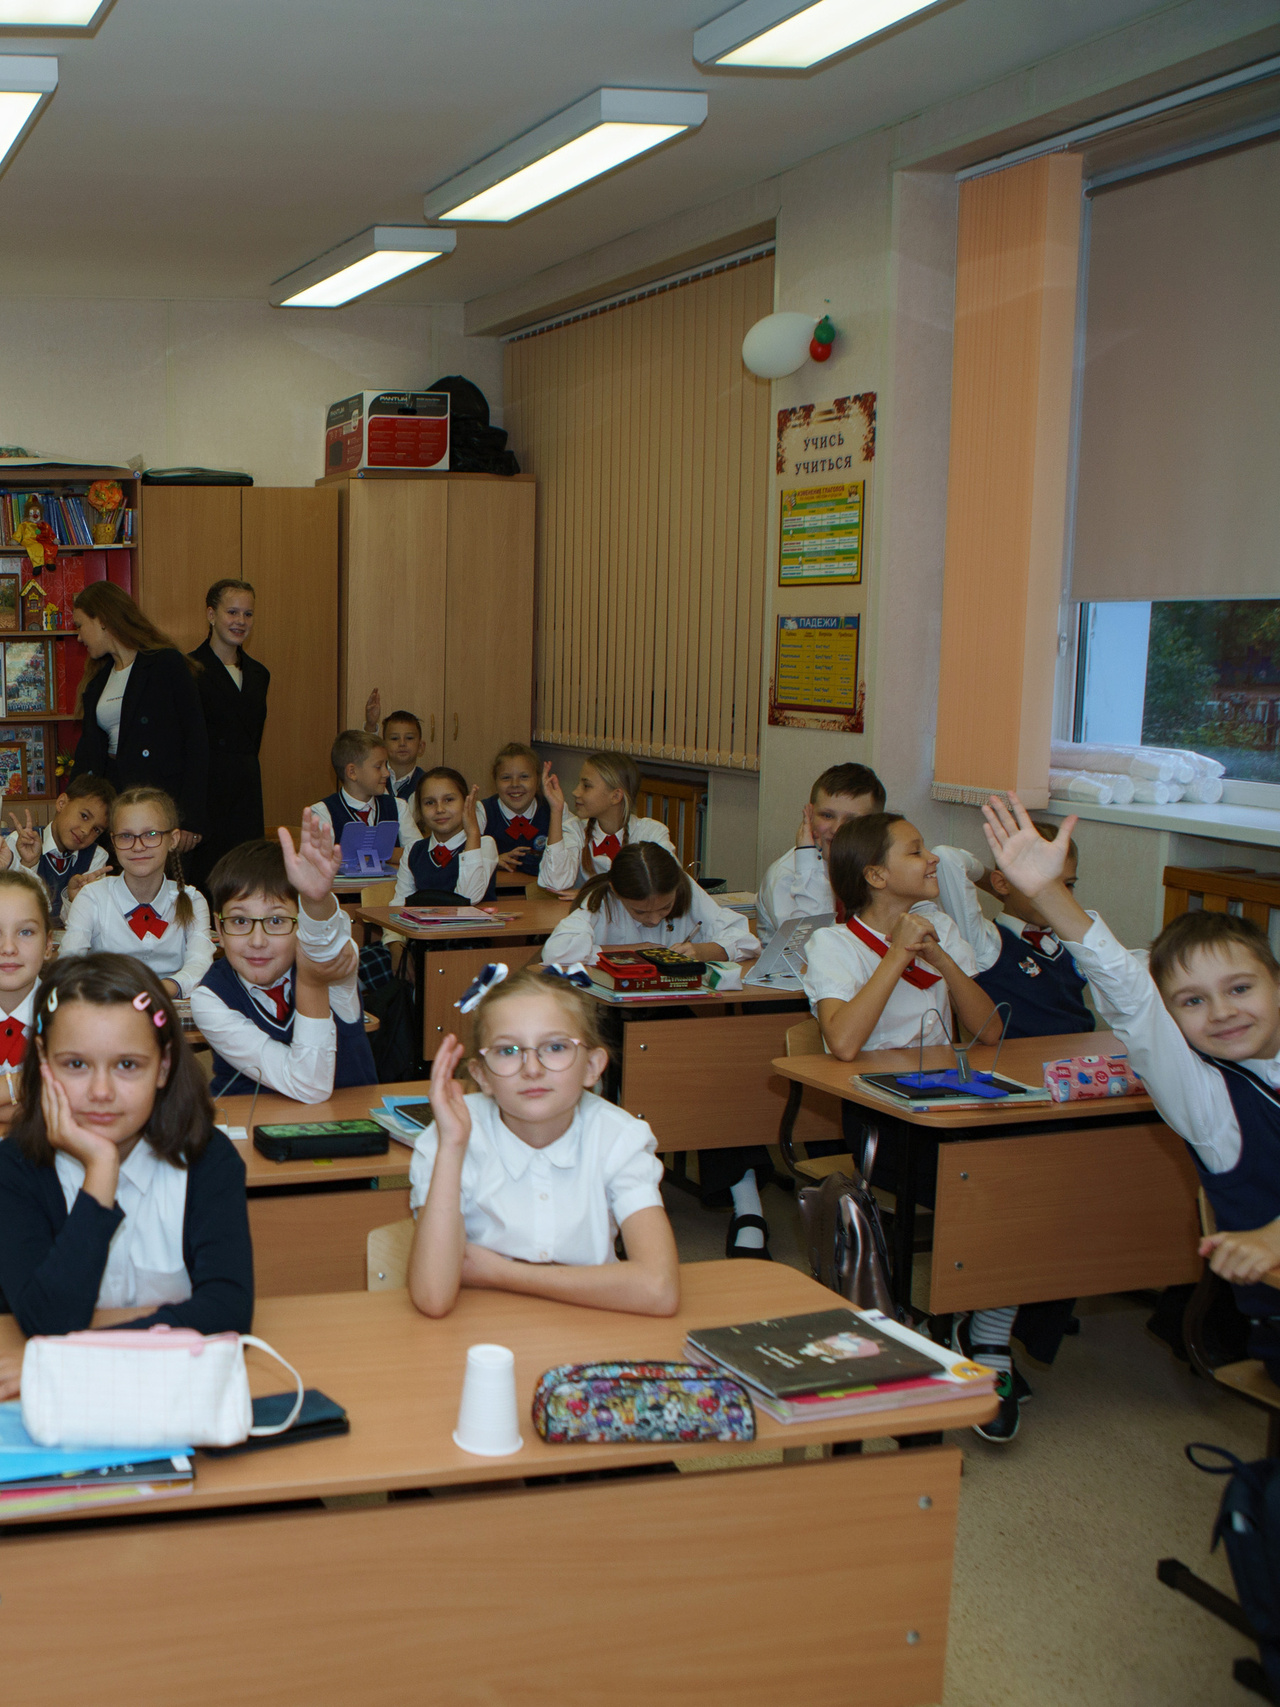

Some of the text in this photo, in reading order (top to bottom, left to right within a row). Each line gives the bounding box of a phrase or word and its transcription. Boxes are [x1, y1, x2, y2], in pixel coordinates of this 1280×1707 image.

[803, 432, 845, 452] УЧИСЬ
[795, 455, 852, 475] УЧИТЬСЯ
[799, 617, 837, 628] ПАДЕЖИ
